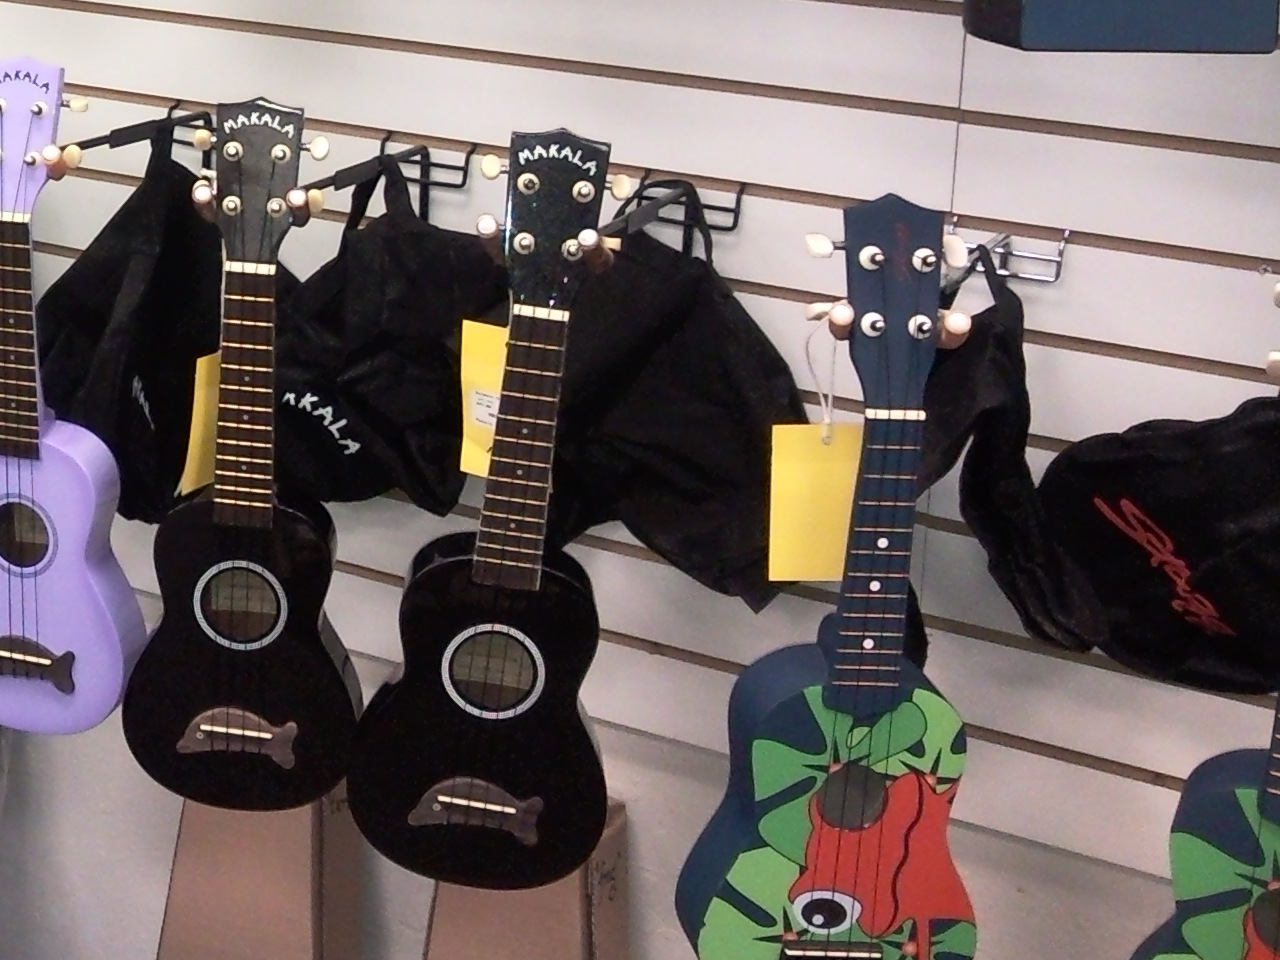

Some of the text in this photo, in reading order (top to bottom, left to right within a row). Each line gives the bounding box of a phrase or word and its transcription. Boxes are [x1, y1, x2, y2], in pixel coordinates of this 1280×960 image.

[223, 111, 295, 140] MAKALA
[517, 143, 598, 177] MAKALA
[281, 391, 362, 455] AKALA
